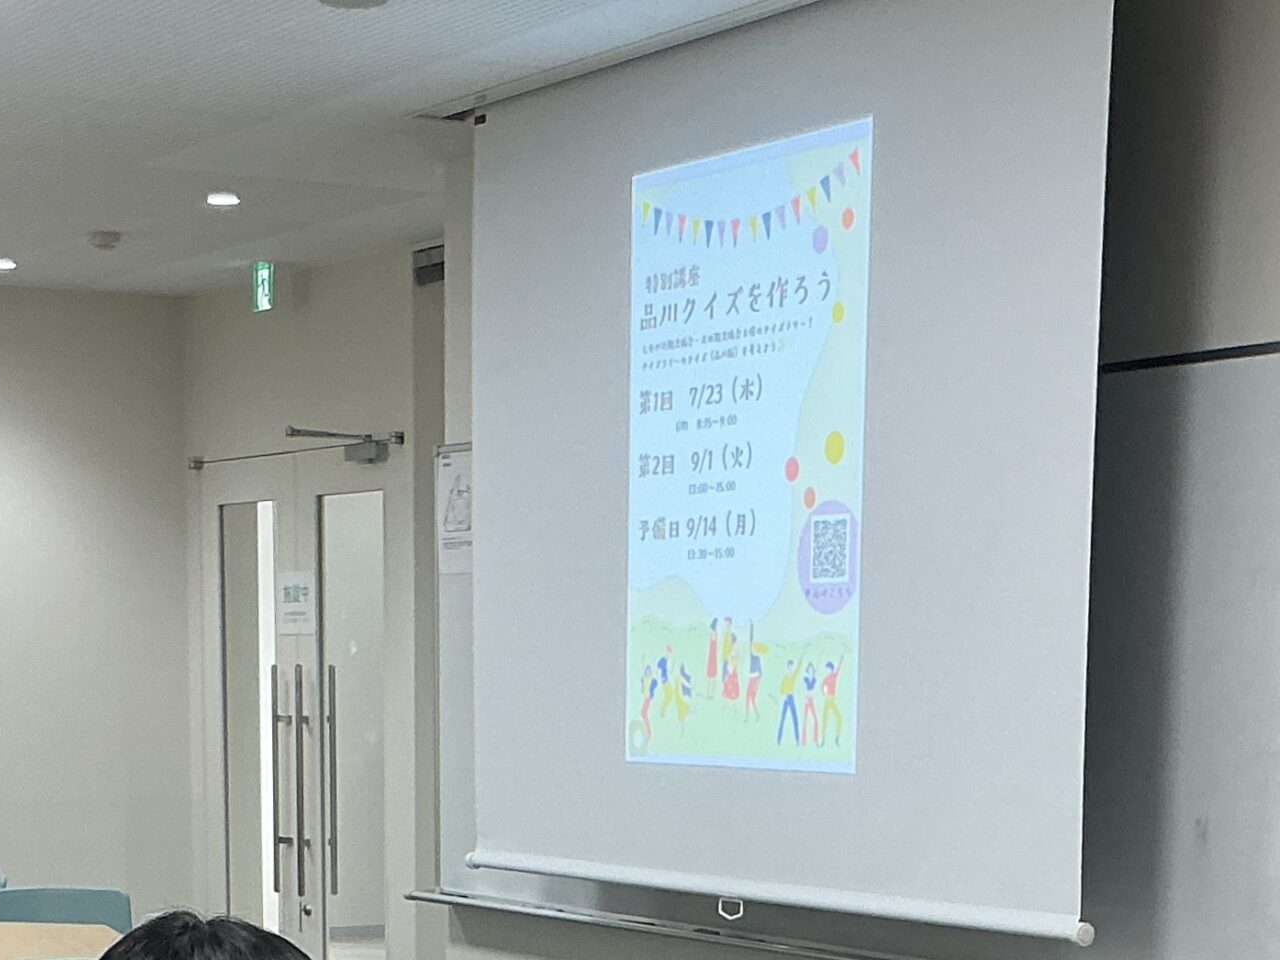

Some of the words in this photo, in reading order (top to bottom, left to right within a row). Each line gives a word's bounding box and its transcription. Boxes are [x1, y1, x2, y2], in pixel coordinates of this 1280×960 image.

[645, 264, 701, 294] 特別講座
[639, 270, 832, 331] 品川クイズを作ろう
[689, 382, 723, 410] 7/23
[638, 452, 675, 479] 第2回
[690, 448, 714, 475] 9/1
[722, 440, 753, 470] (火)
[638, 515, 680, 542] 予備日
[686, 513, 718, 541] 9/14
[725, 507, 757, 537] (月)
